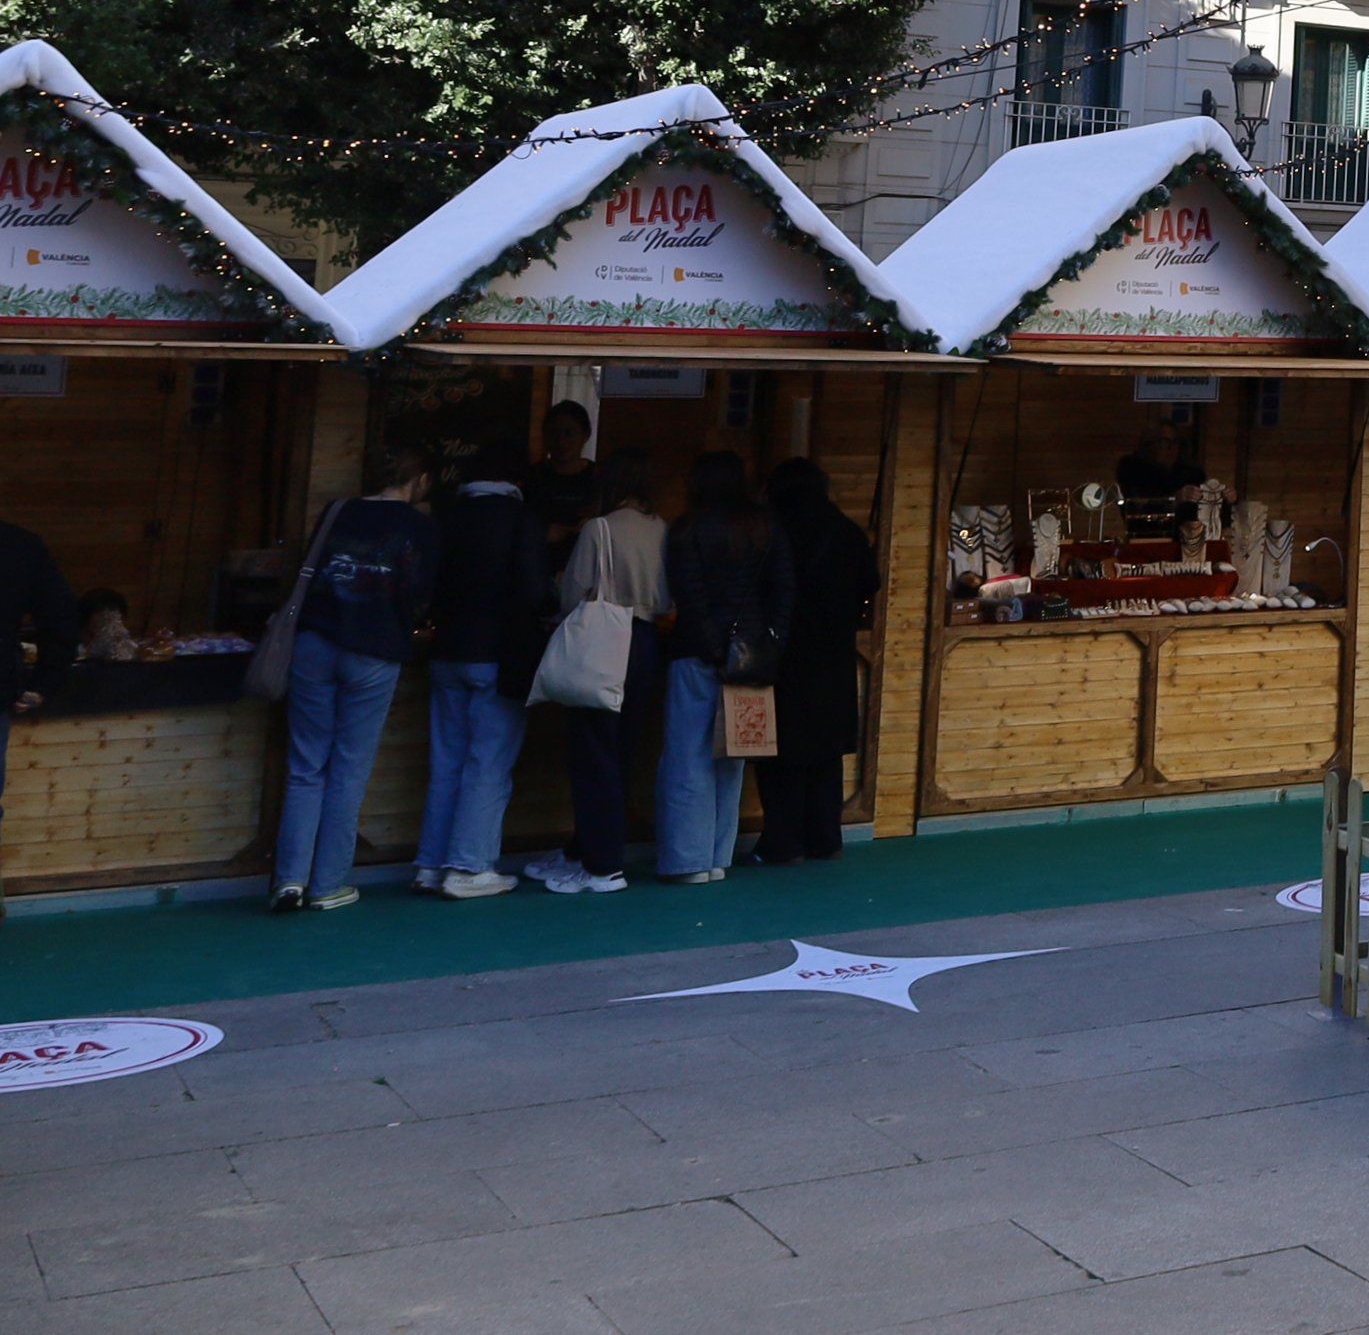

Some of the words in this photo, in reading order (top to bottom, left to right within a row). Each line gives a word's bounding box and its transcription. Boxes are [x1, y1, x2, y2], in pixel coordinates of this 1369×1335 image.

[605, 184, 717, 233] PLAÇA
[618, 228, 646, 242] del
[642, 223, 726, 253] Nadal
[1135, 247, 1156, 260] del
[1154, 241, 1220, 269] Nadal
